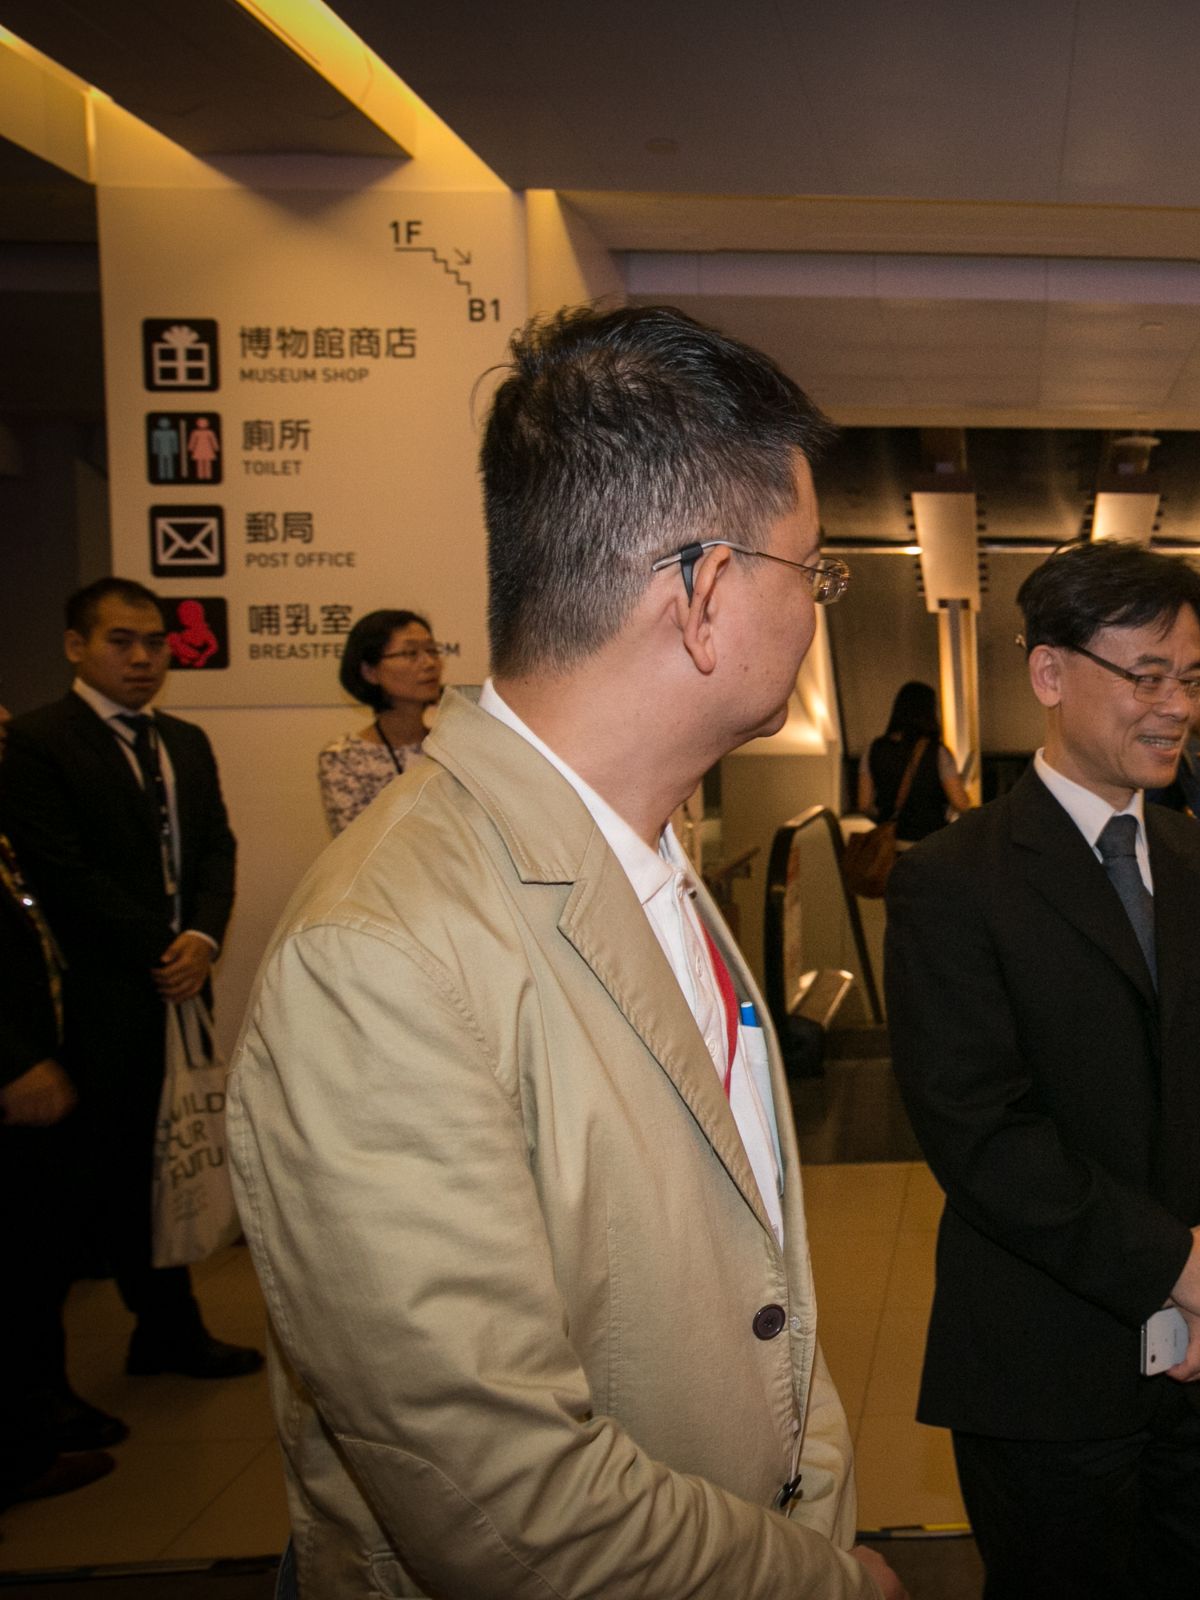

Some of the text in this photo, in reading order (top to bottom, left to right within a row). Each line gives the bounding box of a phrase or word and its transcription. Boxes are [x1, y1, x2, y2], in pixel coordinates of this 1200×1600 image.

[390, 220, 422, 244] 1F
[468, 298, 499, 322] B1
[239, 326, 417, 359] 博物館商店
[239, 368, 370, 383] MUSEUM SHOP
[243, 419, 310, 452] 廁所
[242, 460, 301, 476] TOILET
[246, 511, 314, 544] 郵局
[246, 552, 356, 567] POST OFFICE
[249, 604, 353, 635] 哺乳室
[249, 643, 344, 660] BREASTFE
